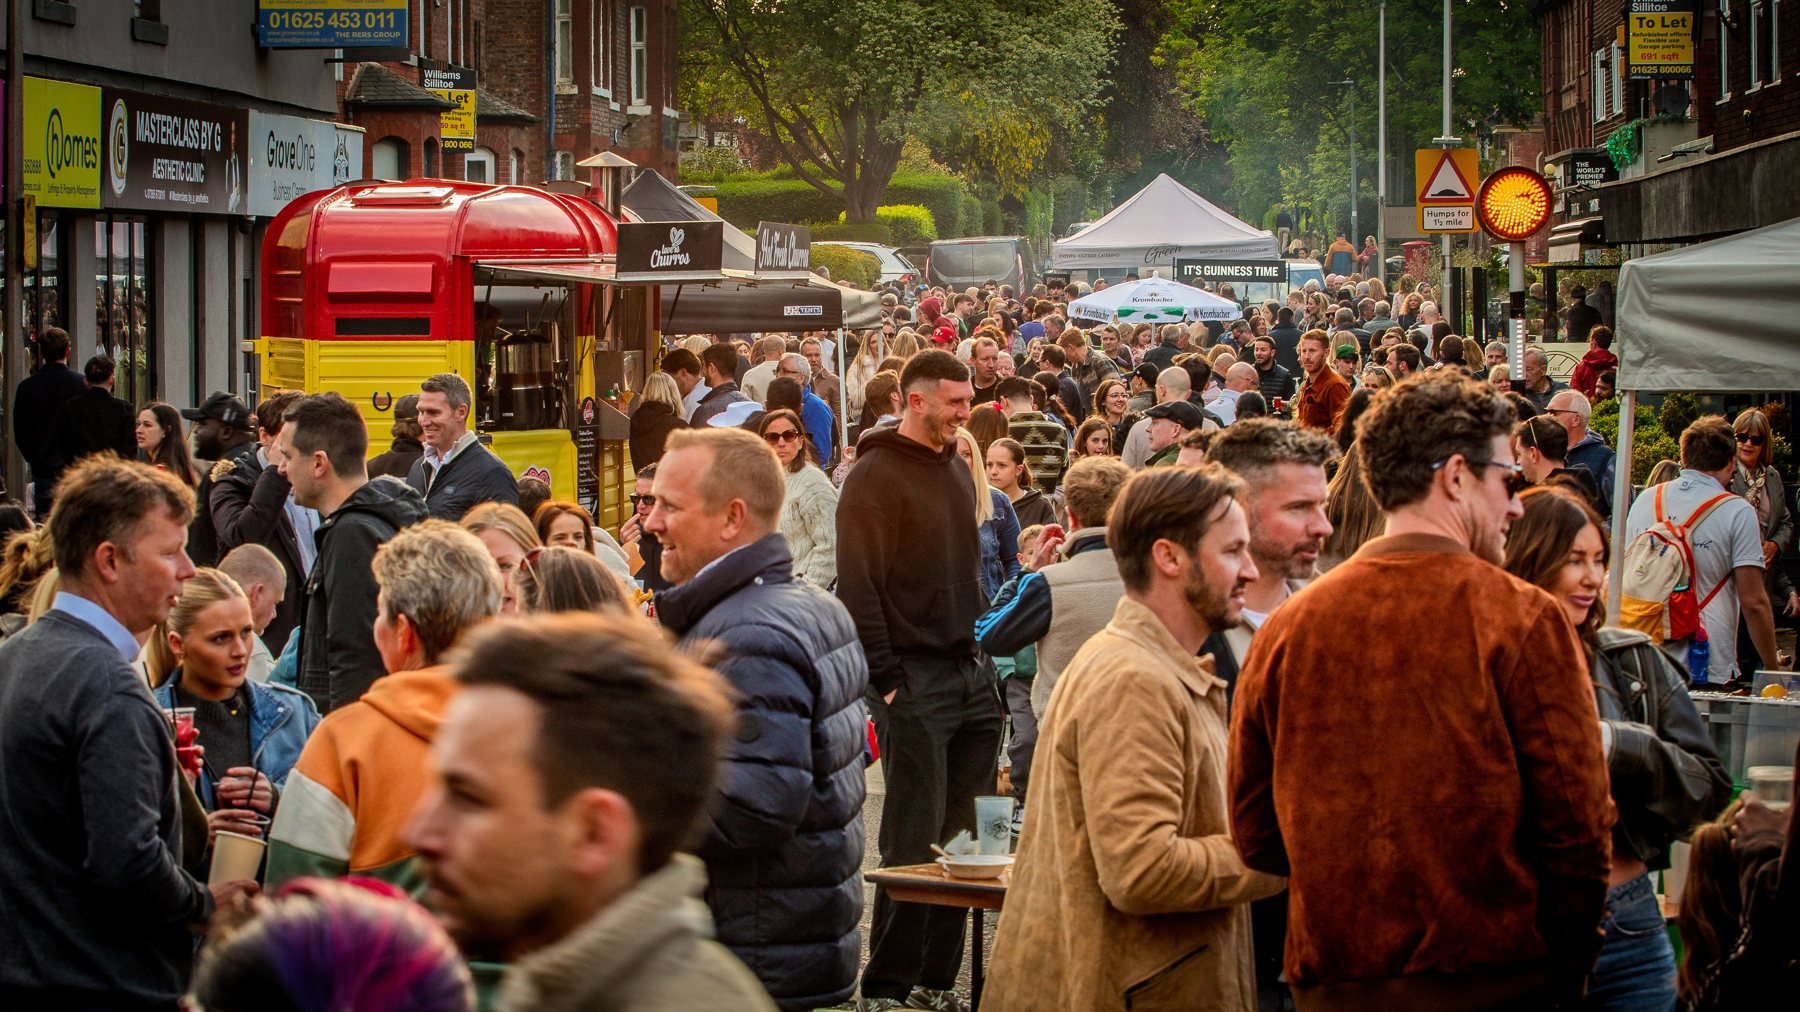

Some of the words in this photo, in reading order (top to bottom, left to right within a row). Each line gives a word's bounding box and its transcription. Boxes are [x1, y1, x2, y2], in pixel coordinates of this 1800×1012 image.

[1632, 3, 1668, 12] Sillitoe
[269, 12, 325, 28] 01625
[327, 12, 361, 28] 453
[365, 12, 395, 28] 011
[1636, 16, 1655, 28] To
[1661, 16, 1688, 28] Let
[1661, 53, 1680, 61] sqft
[424, 70, 461, 80] Williams
[424, 79, 454, 88] Sillitoe
[448, 91, 470, 104] Let
[136, 110, 200, 149] MASTERCLASS
[201, 120, 213, 151] BY
[215, 122, 222, 152] G
[267, 130, 315, 172] GroveOne
[445, 141, 458, 149] 800
[459, 141, 473, 149] 066
[152, 158, 185, 182] AESTHETIC
[185, 161, 205, 184] CLINIC
[273, 180, 292, 201] Business
[1427, 210, 1455, 218] Humps
[661, 244, 673, 255] love
[758, 228, 774, 269] Hot
[772, 230, 788, 268] Fresh
[788, 230, 810, 270] Churros
[1144, 245, 1182, 264] Green
[650, 249, 691, 269] Churros
[1184, 265, 1202, 276] IT'S
[1203, 266, 1253, 276] GUINNESS
[1254, 266, 1279, 277] TIME
[1083, 306, 1110, 320] Krombacher
[1199, 308, 1231, 319] Krombacher
